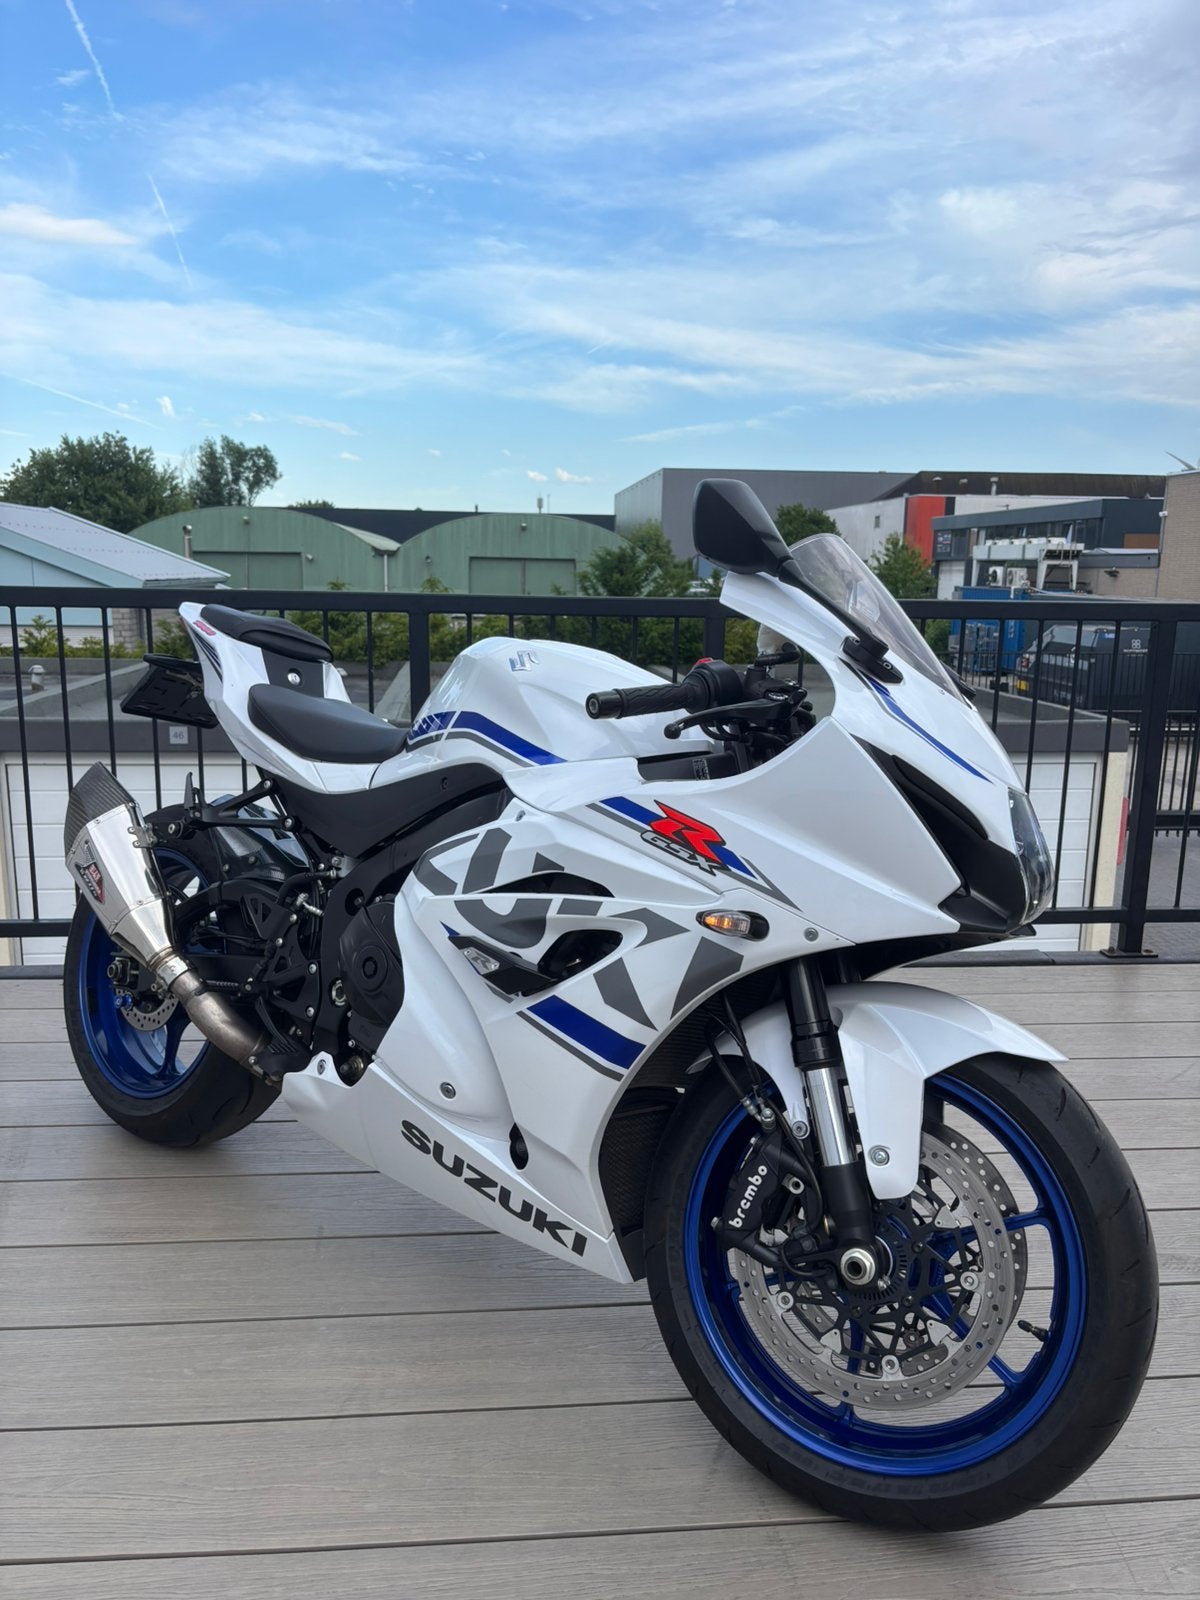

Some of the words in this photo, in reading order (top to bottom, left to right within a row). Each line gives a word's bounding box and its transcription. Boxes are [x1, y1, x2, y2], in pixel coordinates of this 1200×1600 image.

[172, 731, 185, 740] 46
[640, 828, 728, 876] GSX
[649, 799, 727, 866] R
[401, 1119, 588, 1258] SUZUKI
[728, 1165, 768, 1229] brembo
